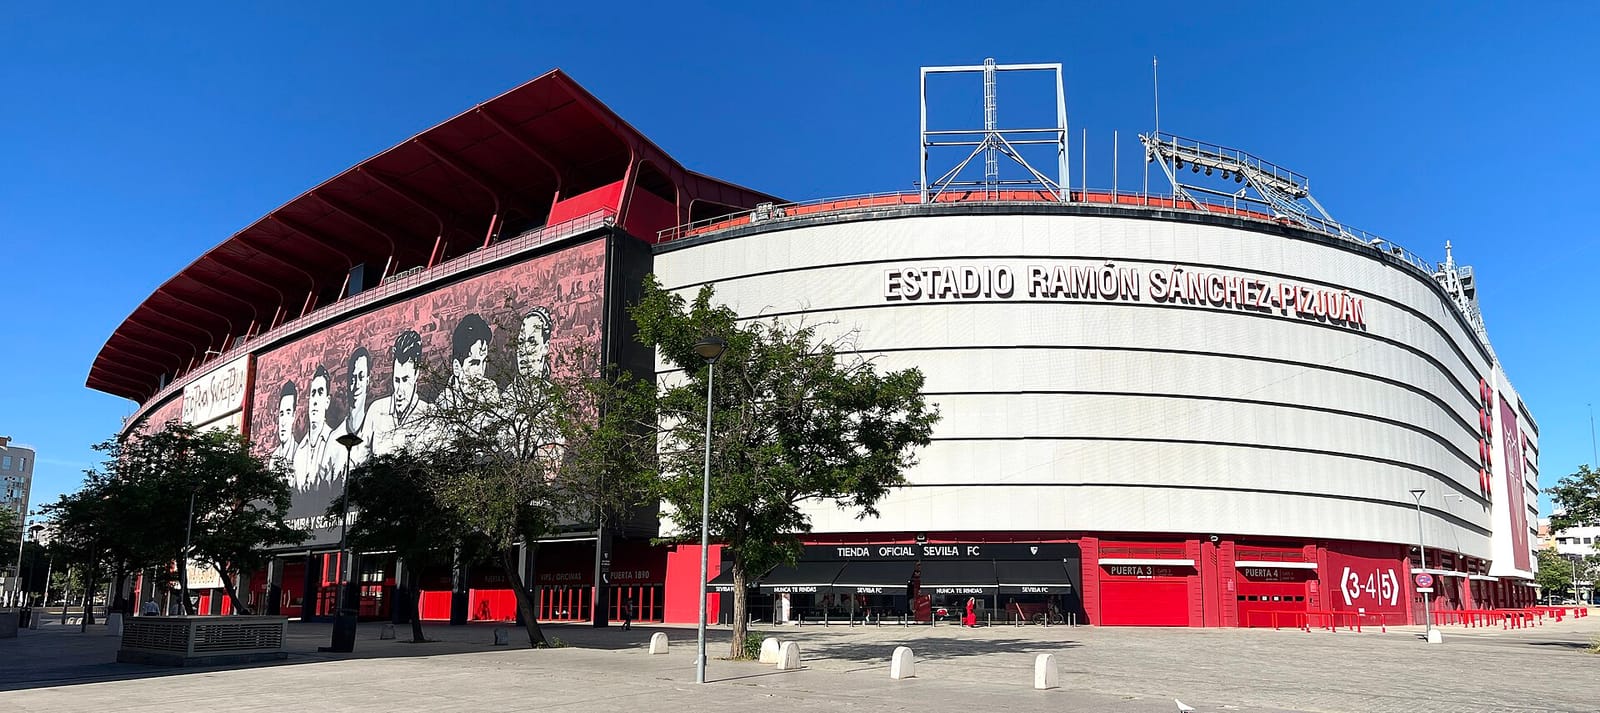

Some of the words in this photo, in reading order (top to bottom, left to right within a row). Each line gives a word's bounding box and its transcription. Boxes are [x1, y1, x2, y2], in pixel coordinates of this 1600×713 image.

[883, 266, 1015, 301] ESTADIO
[1027, 260, 1140, 301] RAMÓN
[837, 547, 870, 557] TIENDA
[878, 546, 915, 557] OFICIAL
[923, 546, 960, 556] SEVILLA
[967, 546, 980, 556] FC
[610, 571, 633, 580] PUERTA
[634, 570, 650, 579] 1890
[1111, 566, 1144, 575] PUERTA
[1146, 566, 1152, 575] 3
[1245, 568, 1272, 577] PUERTA
[1273, 569, 1279, 577] 4
